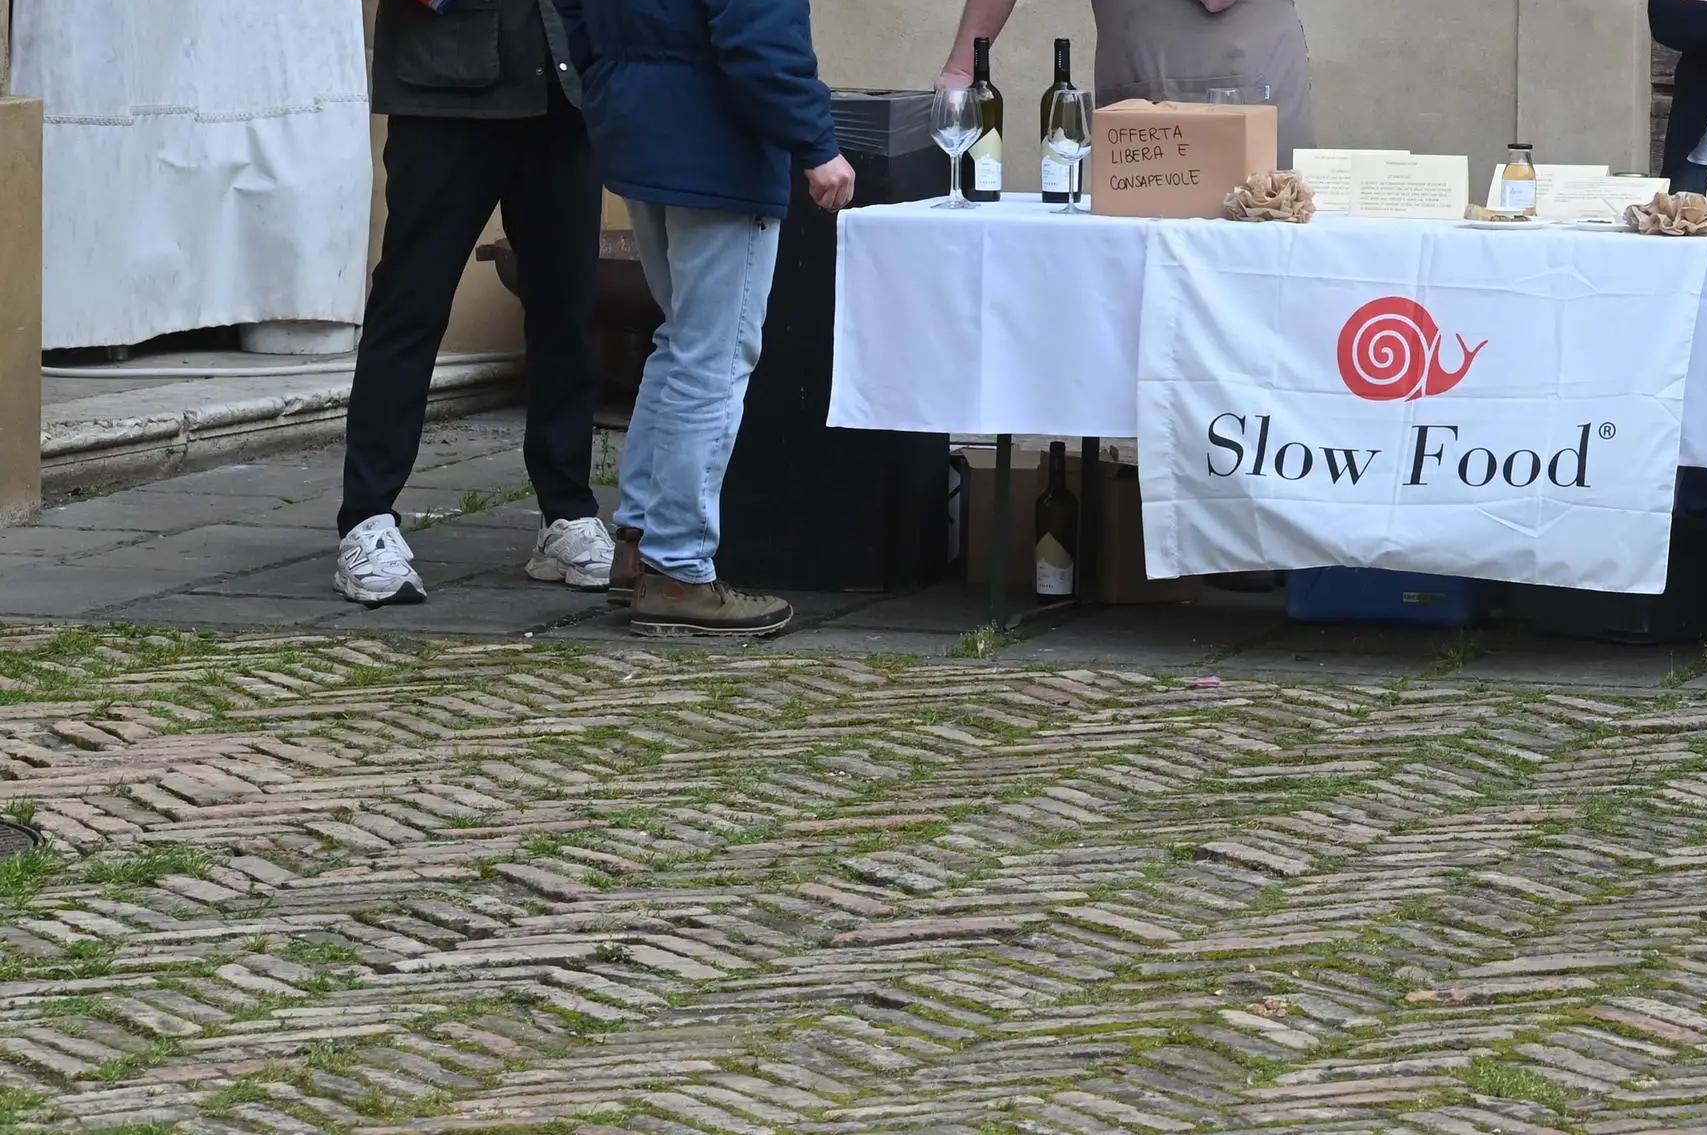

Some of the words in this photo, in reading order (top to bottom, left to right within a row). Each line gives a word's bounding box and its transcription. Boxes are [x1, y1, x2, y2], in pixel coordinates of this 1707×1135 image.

[1107, 125, 1183, 145] OFFERTA
[1111, 145, 1163, 164] LIBERA
[1177, 143, 1191, 157] E
[1110, 169, 1201, 191] CONSAPEVOLE
[1206, 412, 1382, 486] Slow
